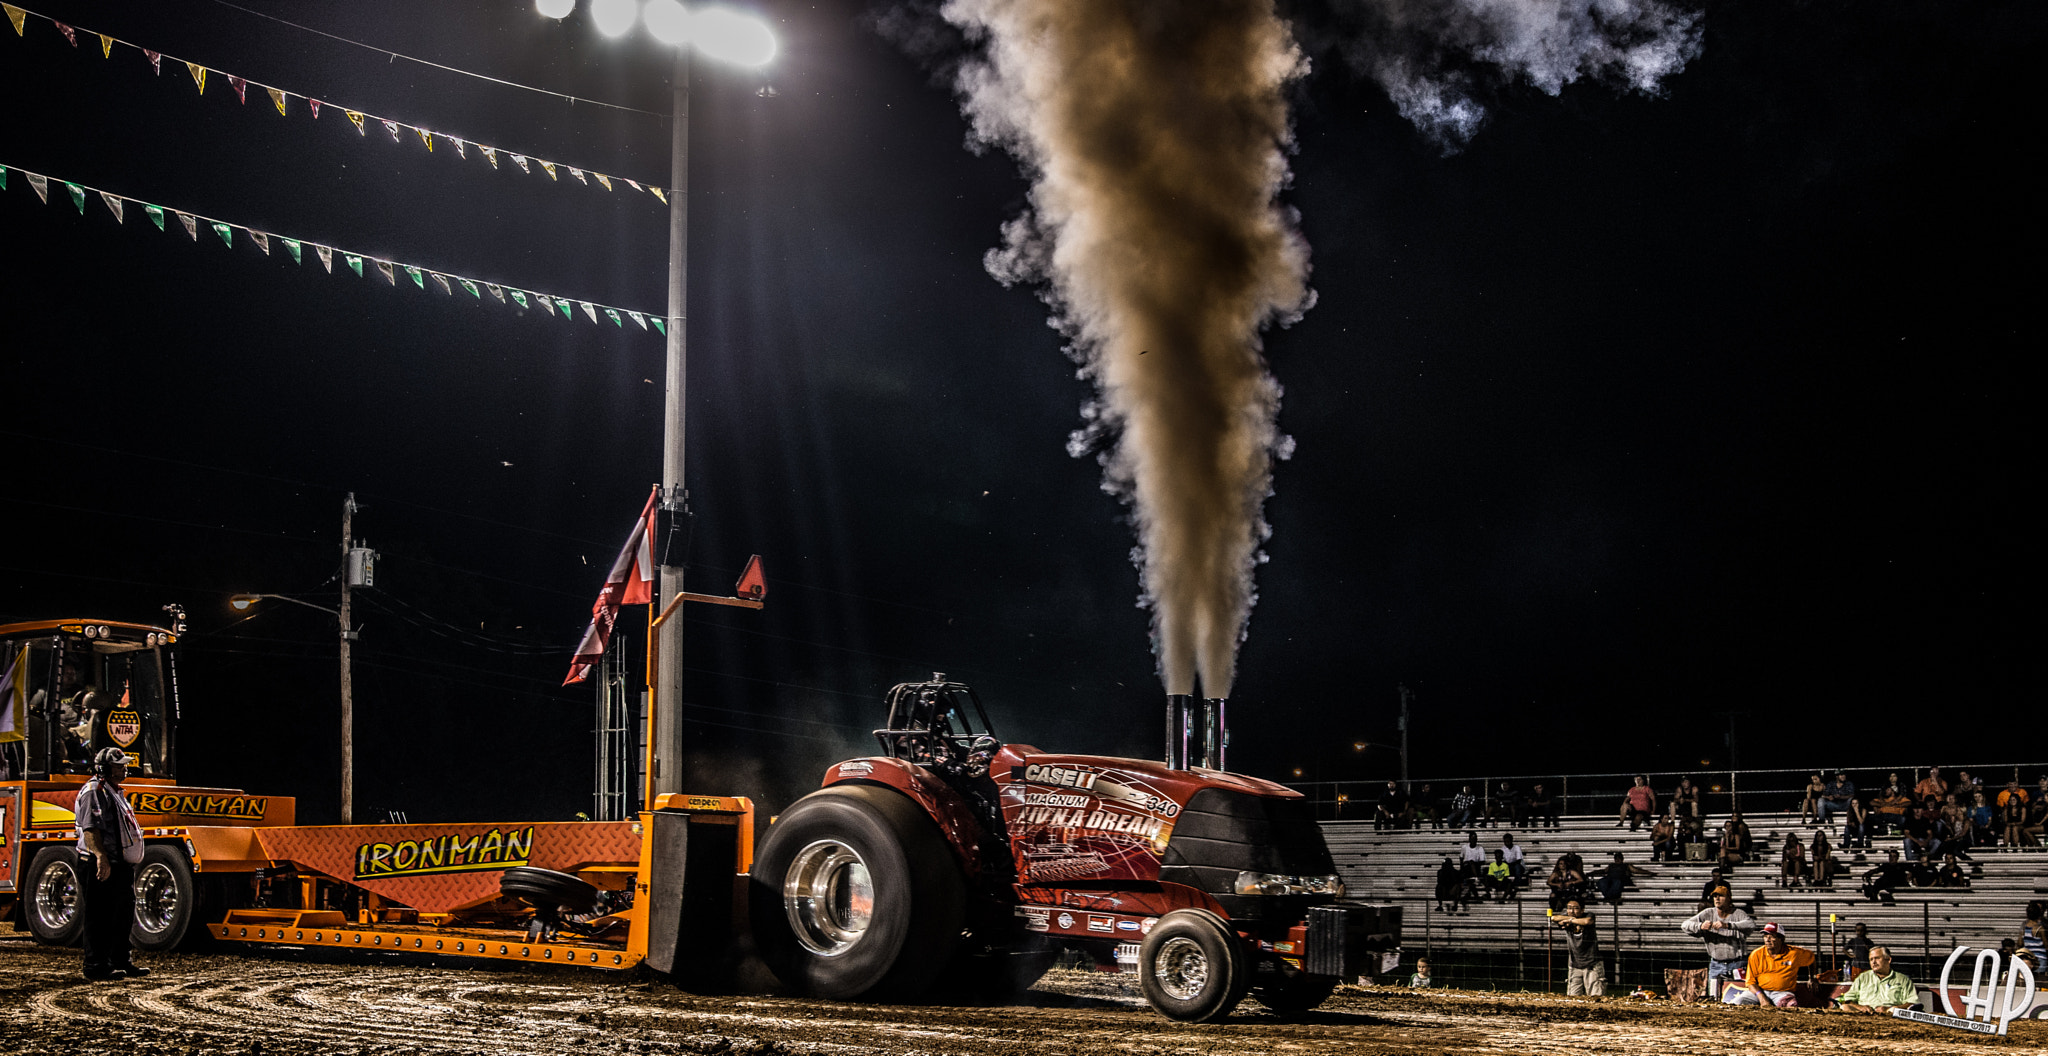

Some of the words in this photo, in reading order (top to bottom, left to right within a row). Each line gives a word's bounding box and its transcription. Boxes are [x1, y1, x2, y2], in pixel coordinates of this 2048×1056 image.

[115, 724, 133, 735] NTPA
[129, 792, 267, 815] IRONMAN
[1027, 793, 1090, 808] MAGNUM
[1146, 796, 1179, 817] 340
[1085, 811, 1164, 838] DREAM
[357, 827, 535, 874] IRONMAN
